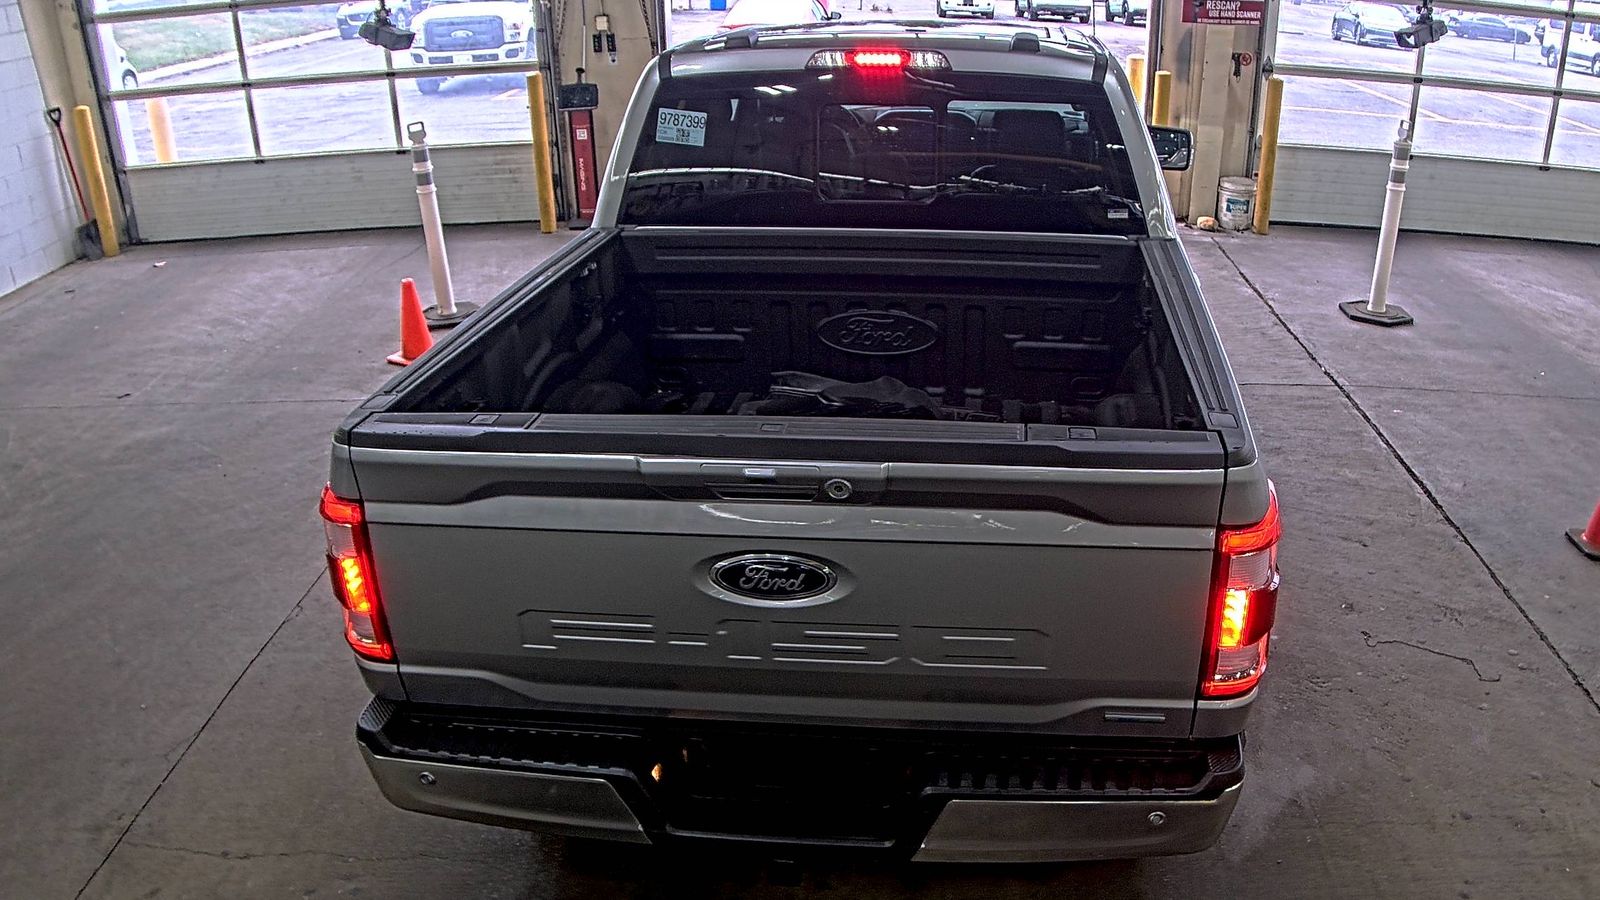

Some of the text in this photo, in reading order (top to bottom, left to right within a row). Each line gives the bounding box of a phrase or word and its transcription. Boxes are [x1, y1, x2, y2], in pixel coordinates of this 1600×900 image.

[1206, 0, 1240, 10] RESCAN?
[1220, 10, 1235, 18] HAND
[1236, 11, 1261, 19] SCANNER
[659, 112, 706, 129] 9787399
[839, 316, 913, 346] Ford
[738, 564, 805, 591] Ford
[518, 609, 1050, 671] F-150
